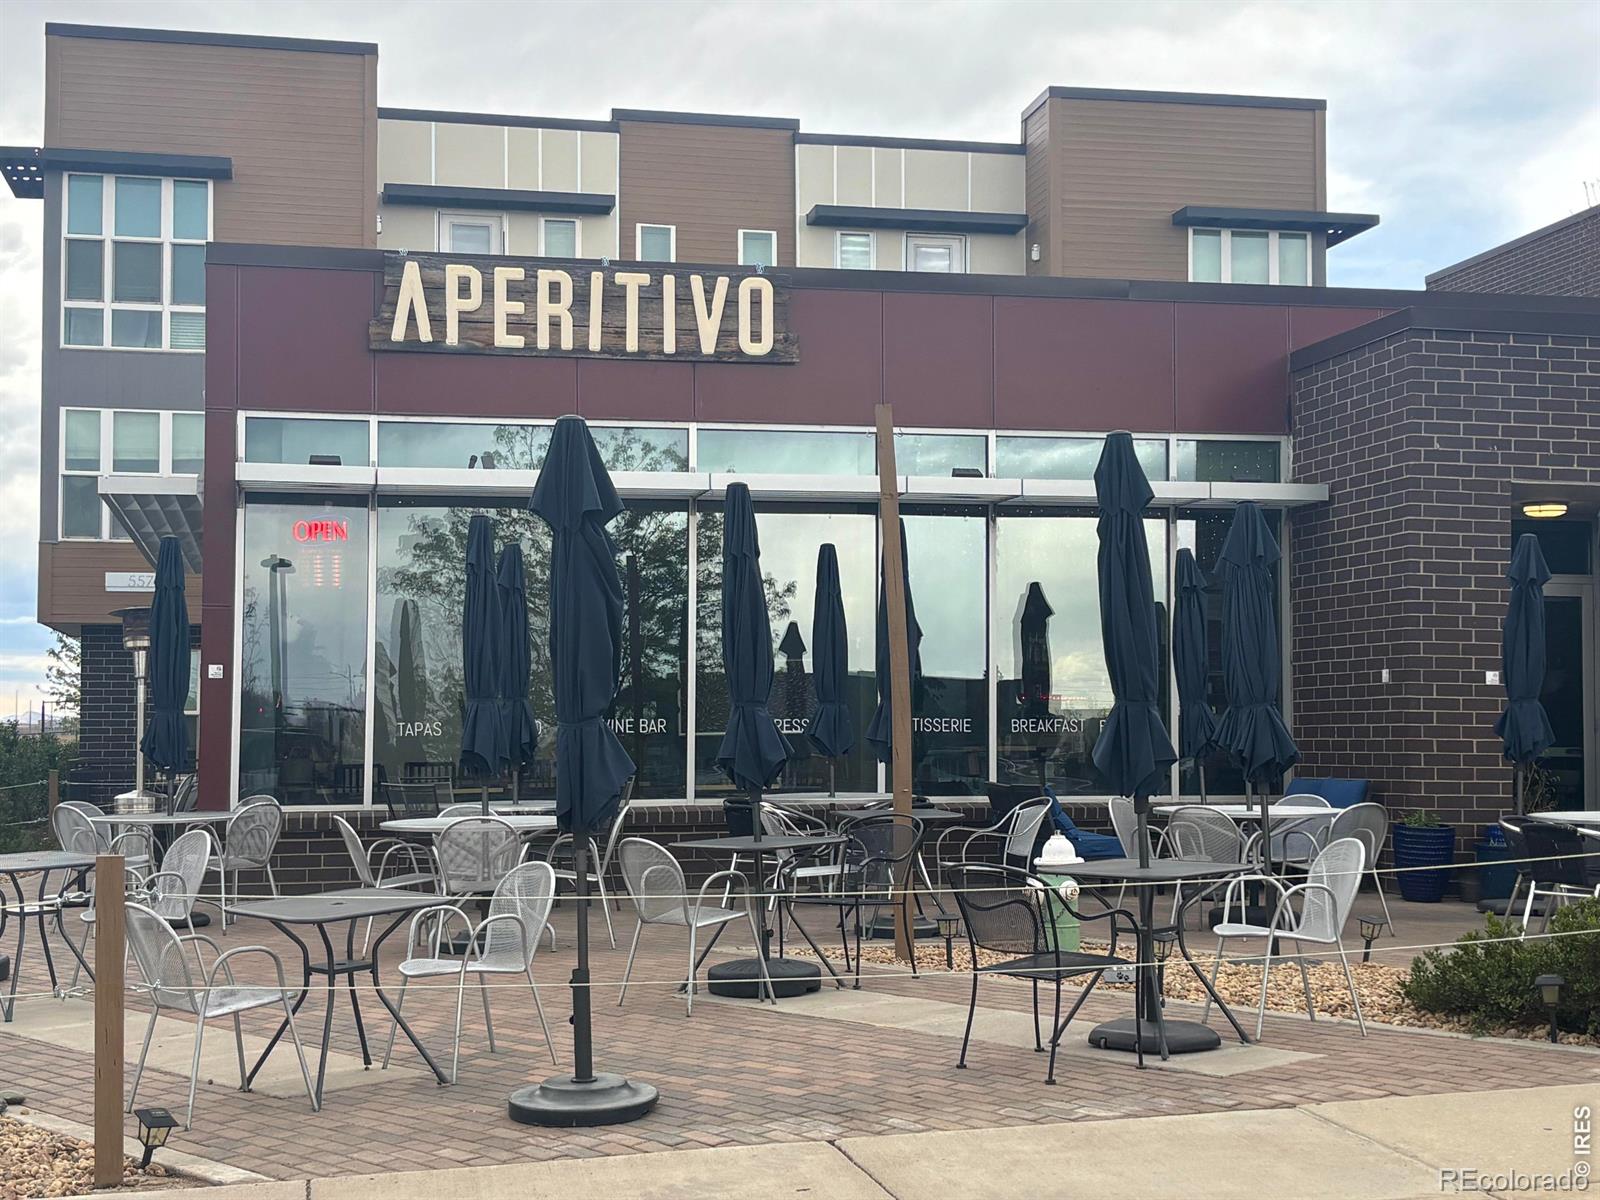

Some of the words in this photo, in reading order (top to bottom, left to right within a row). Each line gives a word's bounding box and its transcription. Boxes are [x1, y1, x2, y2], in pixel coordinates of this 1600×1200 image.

[390, 260, 775, 357] APERITIVO
[293, 520, 348, 542] OPEN
[128, 575, 155, 588] 557
[397, 721, 442, 737] TAPAS
[639, 718, 667, 733] BAR
[773, 718, 810, 733] RESS
[912, 717, 972, 732] TISSERIE
[1011, 718, 1085, 733] BREAKFAST
